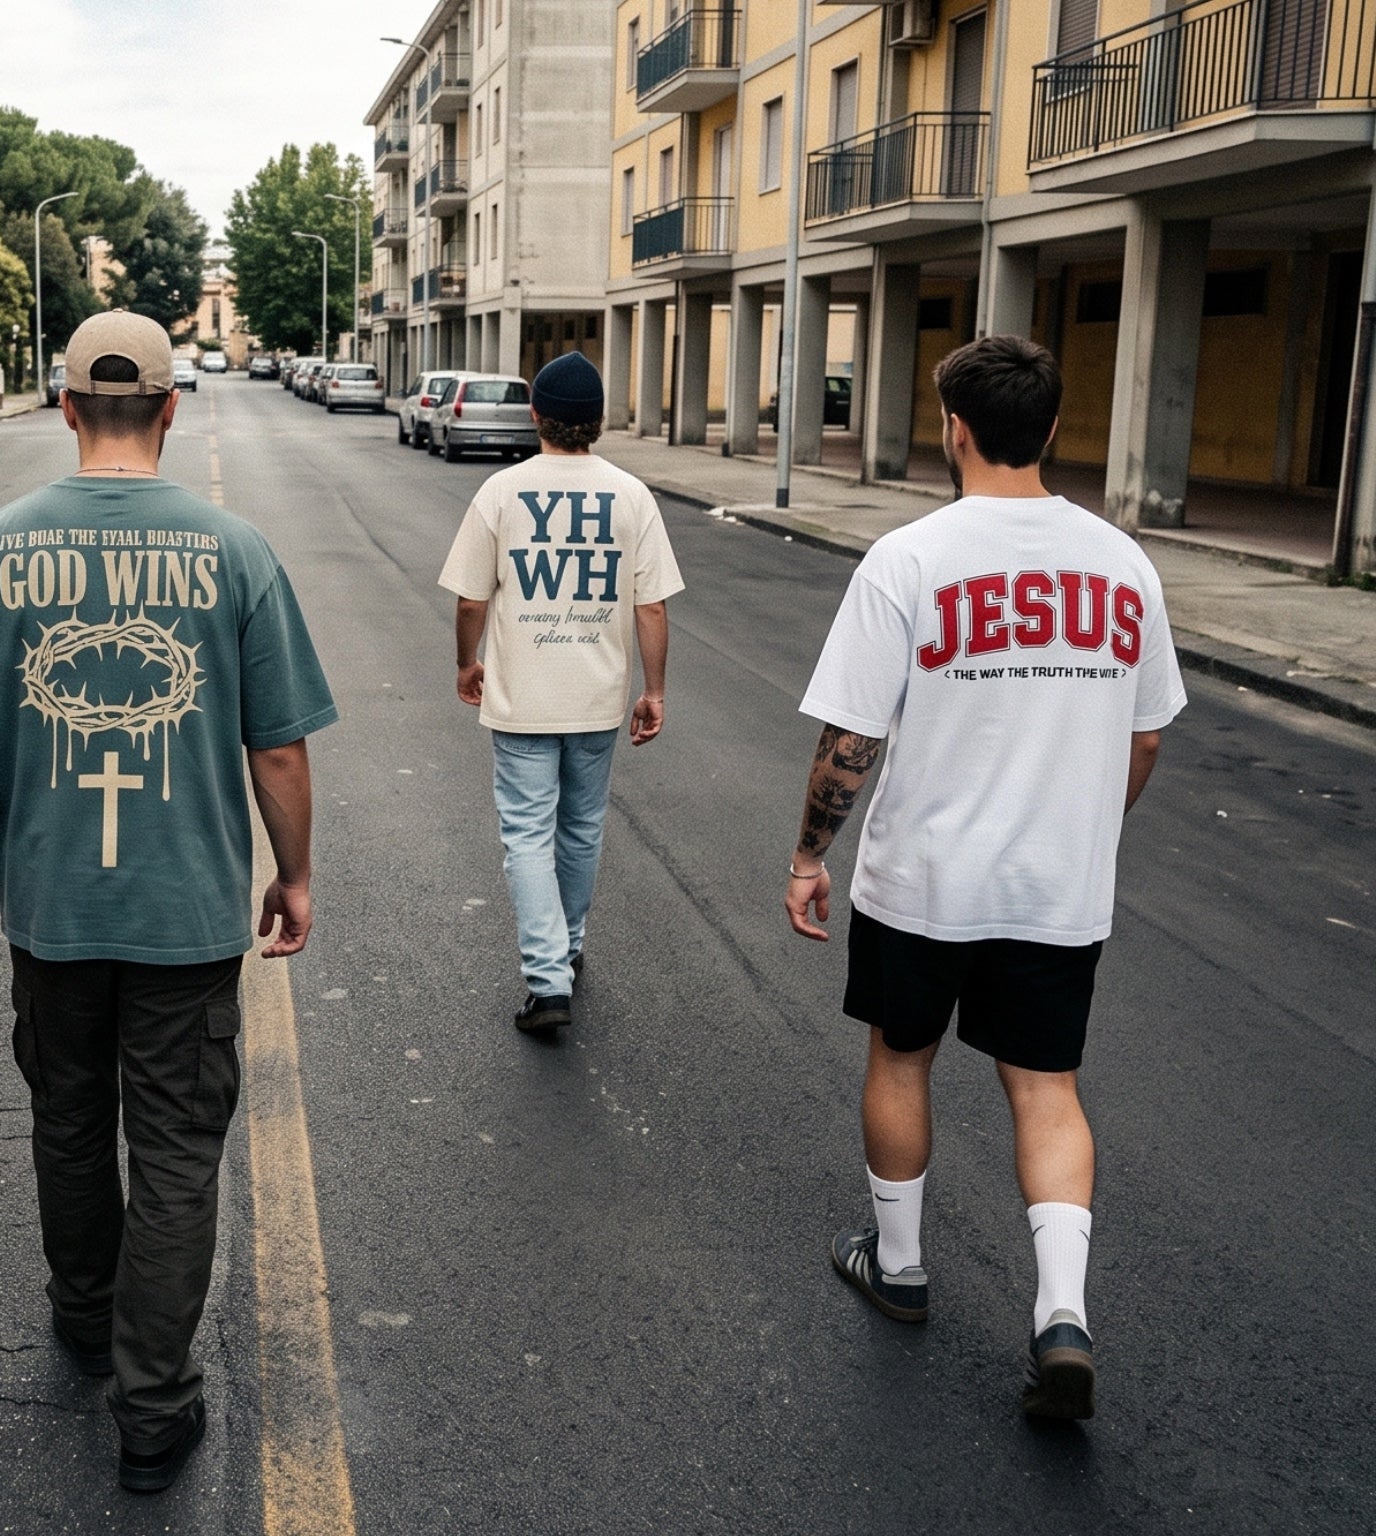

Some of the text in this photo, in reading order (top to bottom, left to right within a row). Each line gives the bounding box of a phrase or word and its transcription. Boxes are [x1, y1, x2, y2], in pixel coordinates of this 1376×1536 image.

[68, 528, 97, 546] THE
[518, 491, 616, 544] YH
[0, 549, 219, 610] GOD WINS
[508, 548, 622, 602] WH
[916, 569, 1145, 673] JESUS
[953, 669, 977, 681] THE
[979, 668, 1005, 680] WAY
[1007, 666, 1029, 679] THE
[1031, 666, 1073, 678] TRUTH
